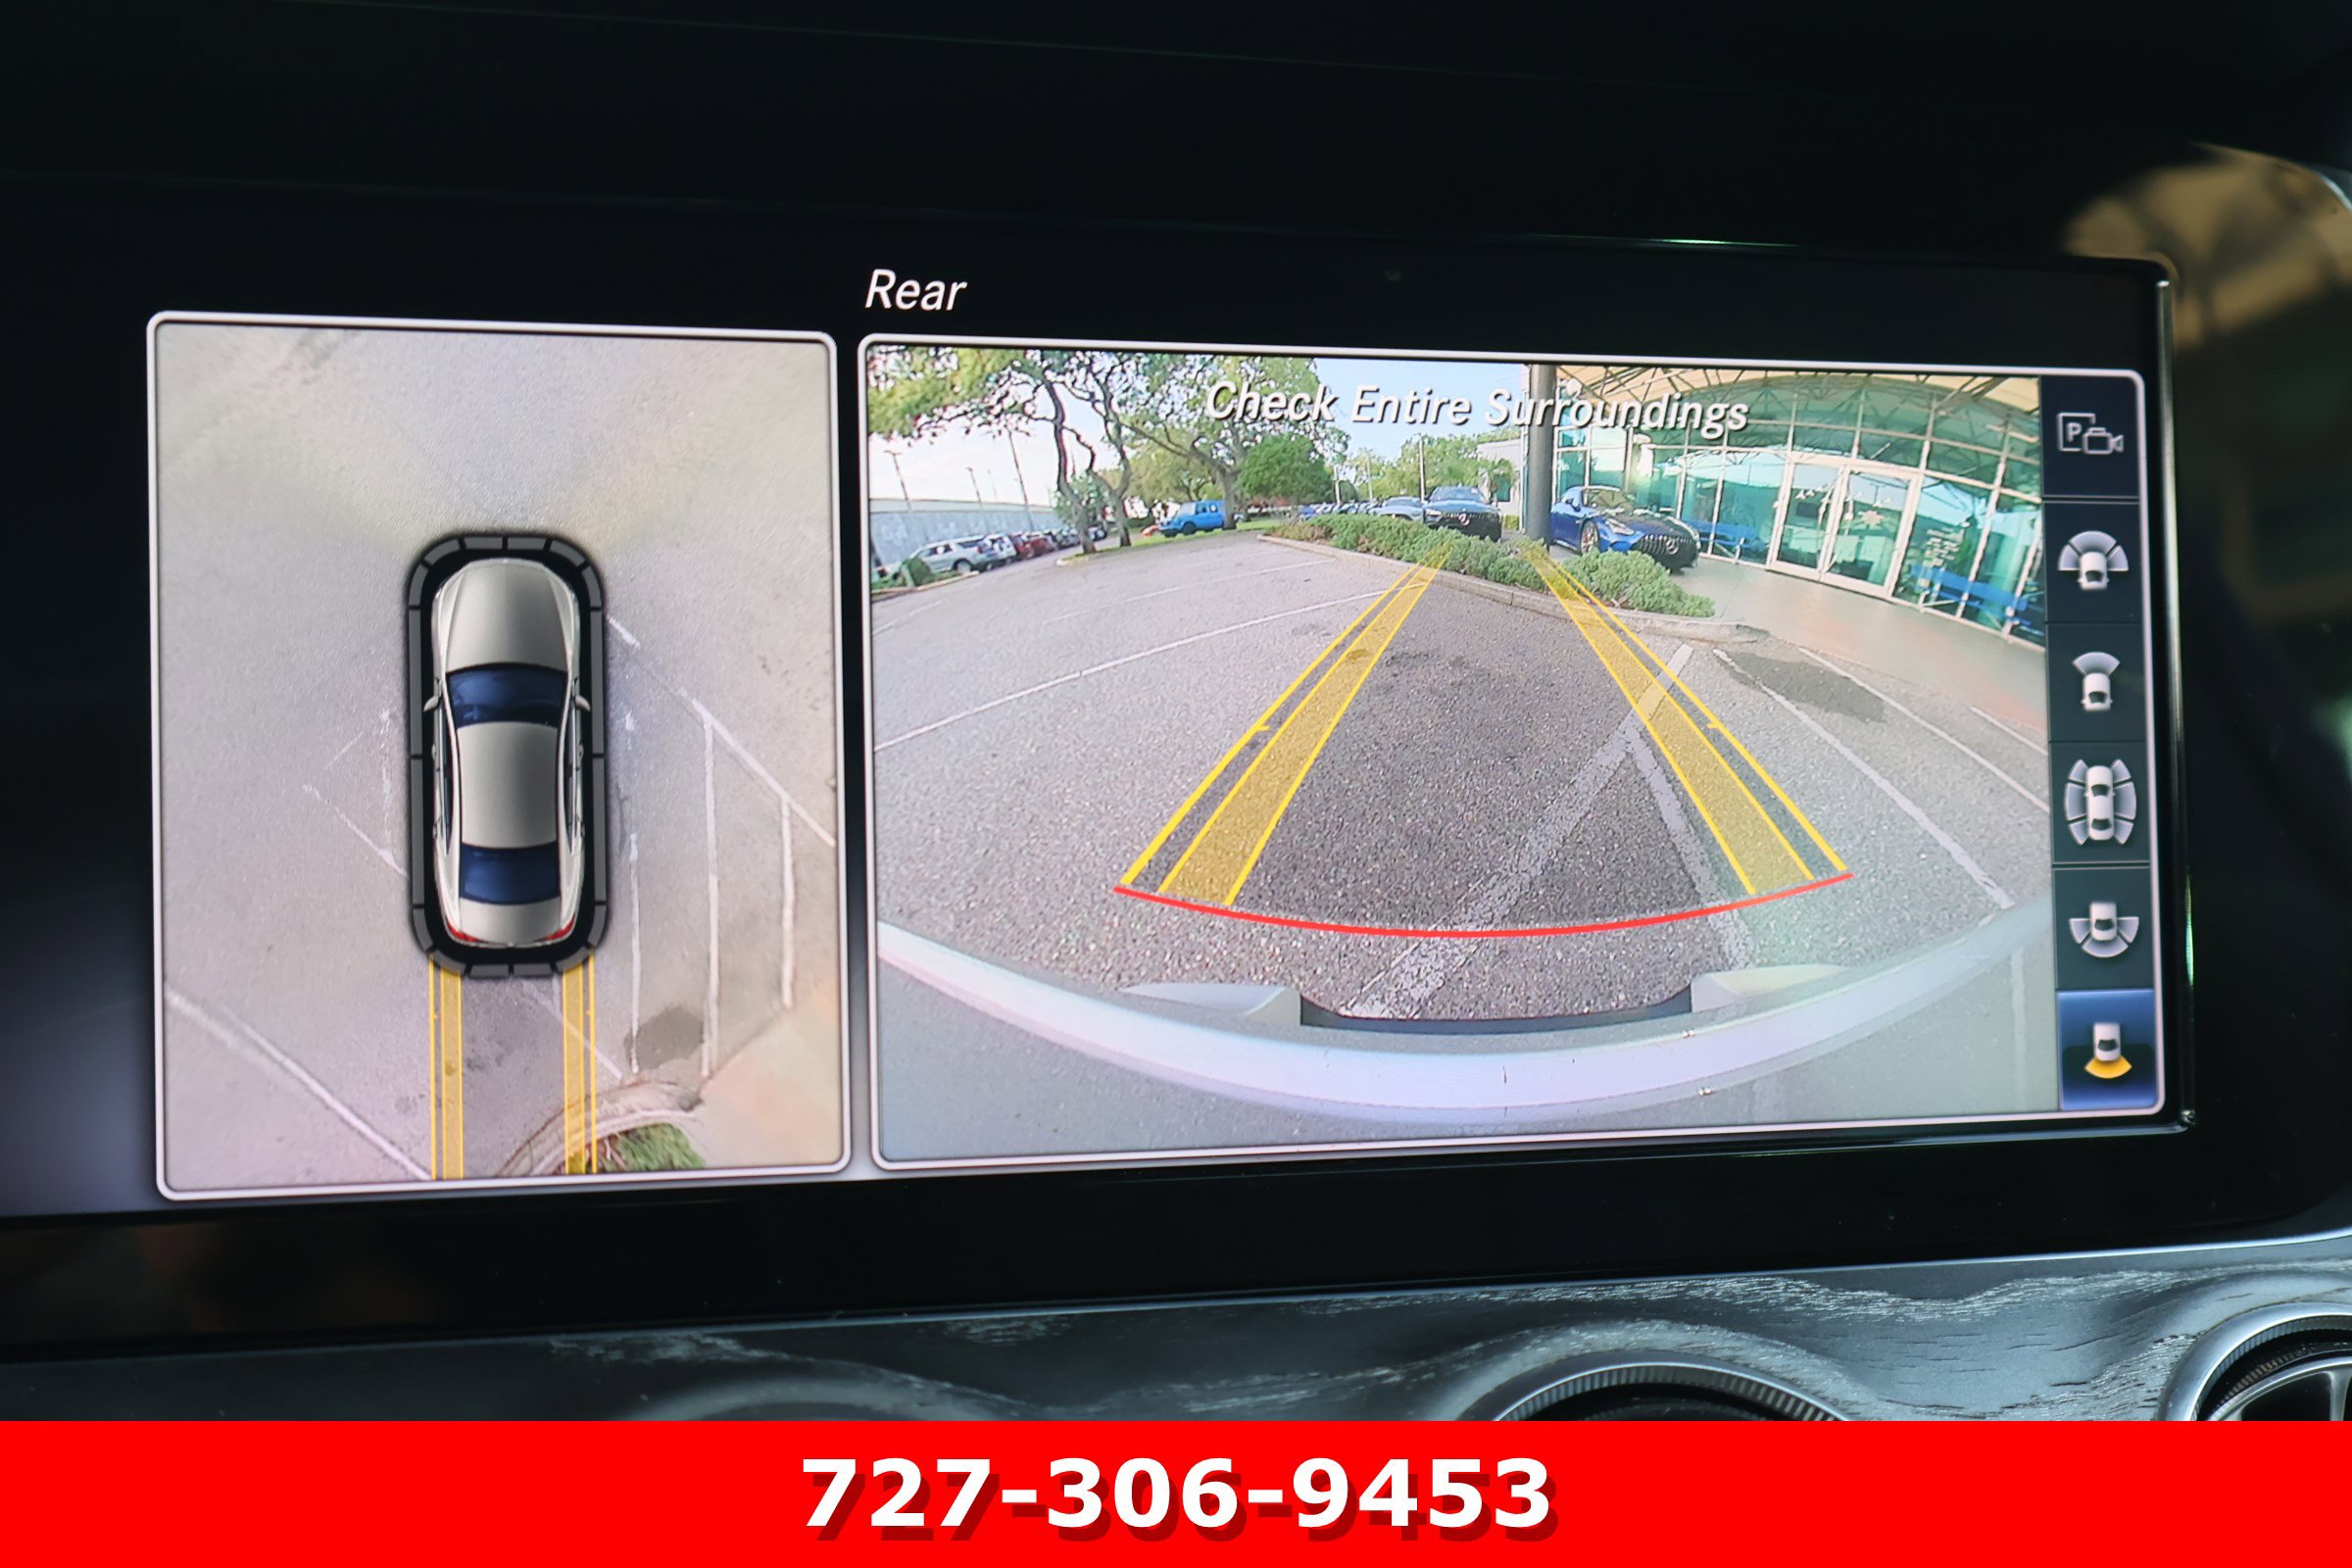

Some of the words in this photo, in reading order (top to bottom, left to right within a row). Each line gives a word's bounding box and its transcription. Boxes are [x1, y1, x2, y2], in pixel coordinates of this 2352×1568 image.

[864, 269, 968, 312] Rear
[1205, 380, 1338, 423] Check
[1351, 384, 1472, 425] Entire
[1485, 388, 1750, 440] Surroundings
[2067, 421, 2082, 442] P
